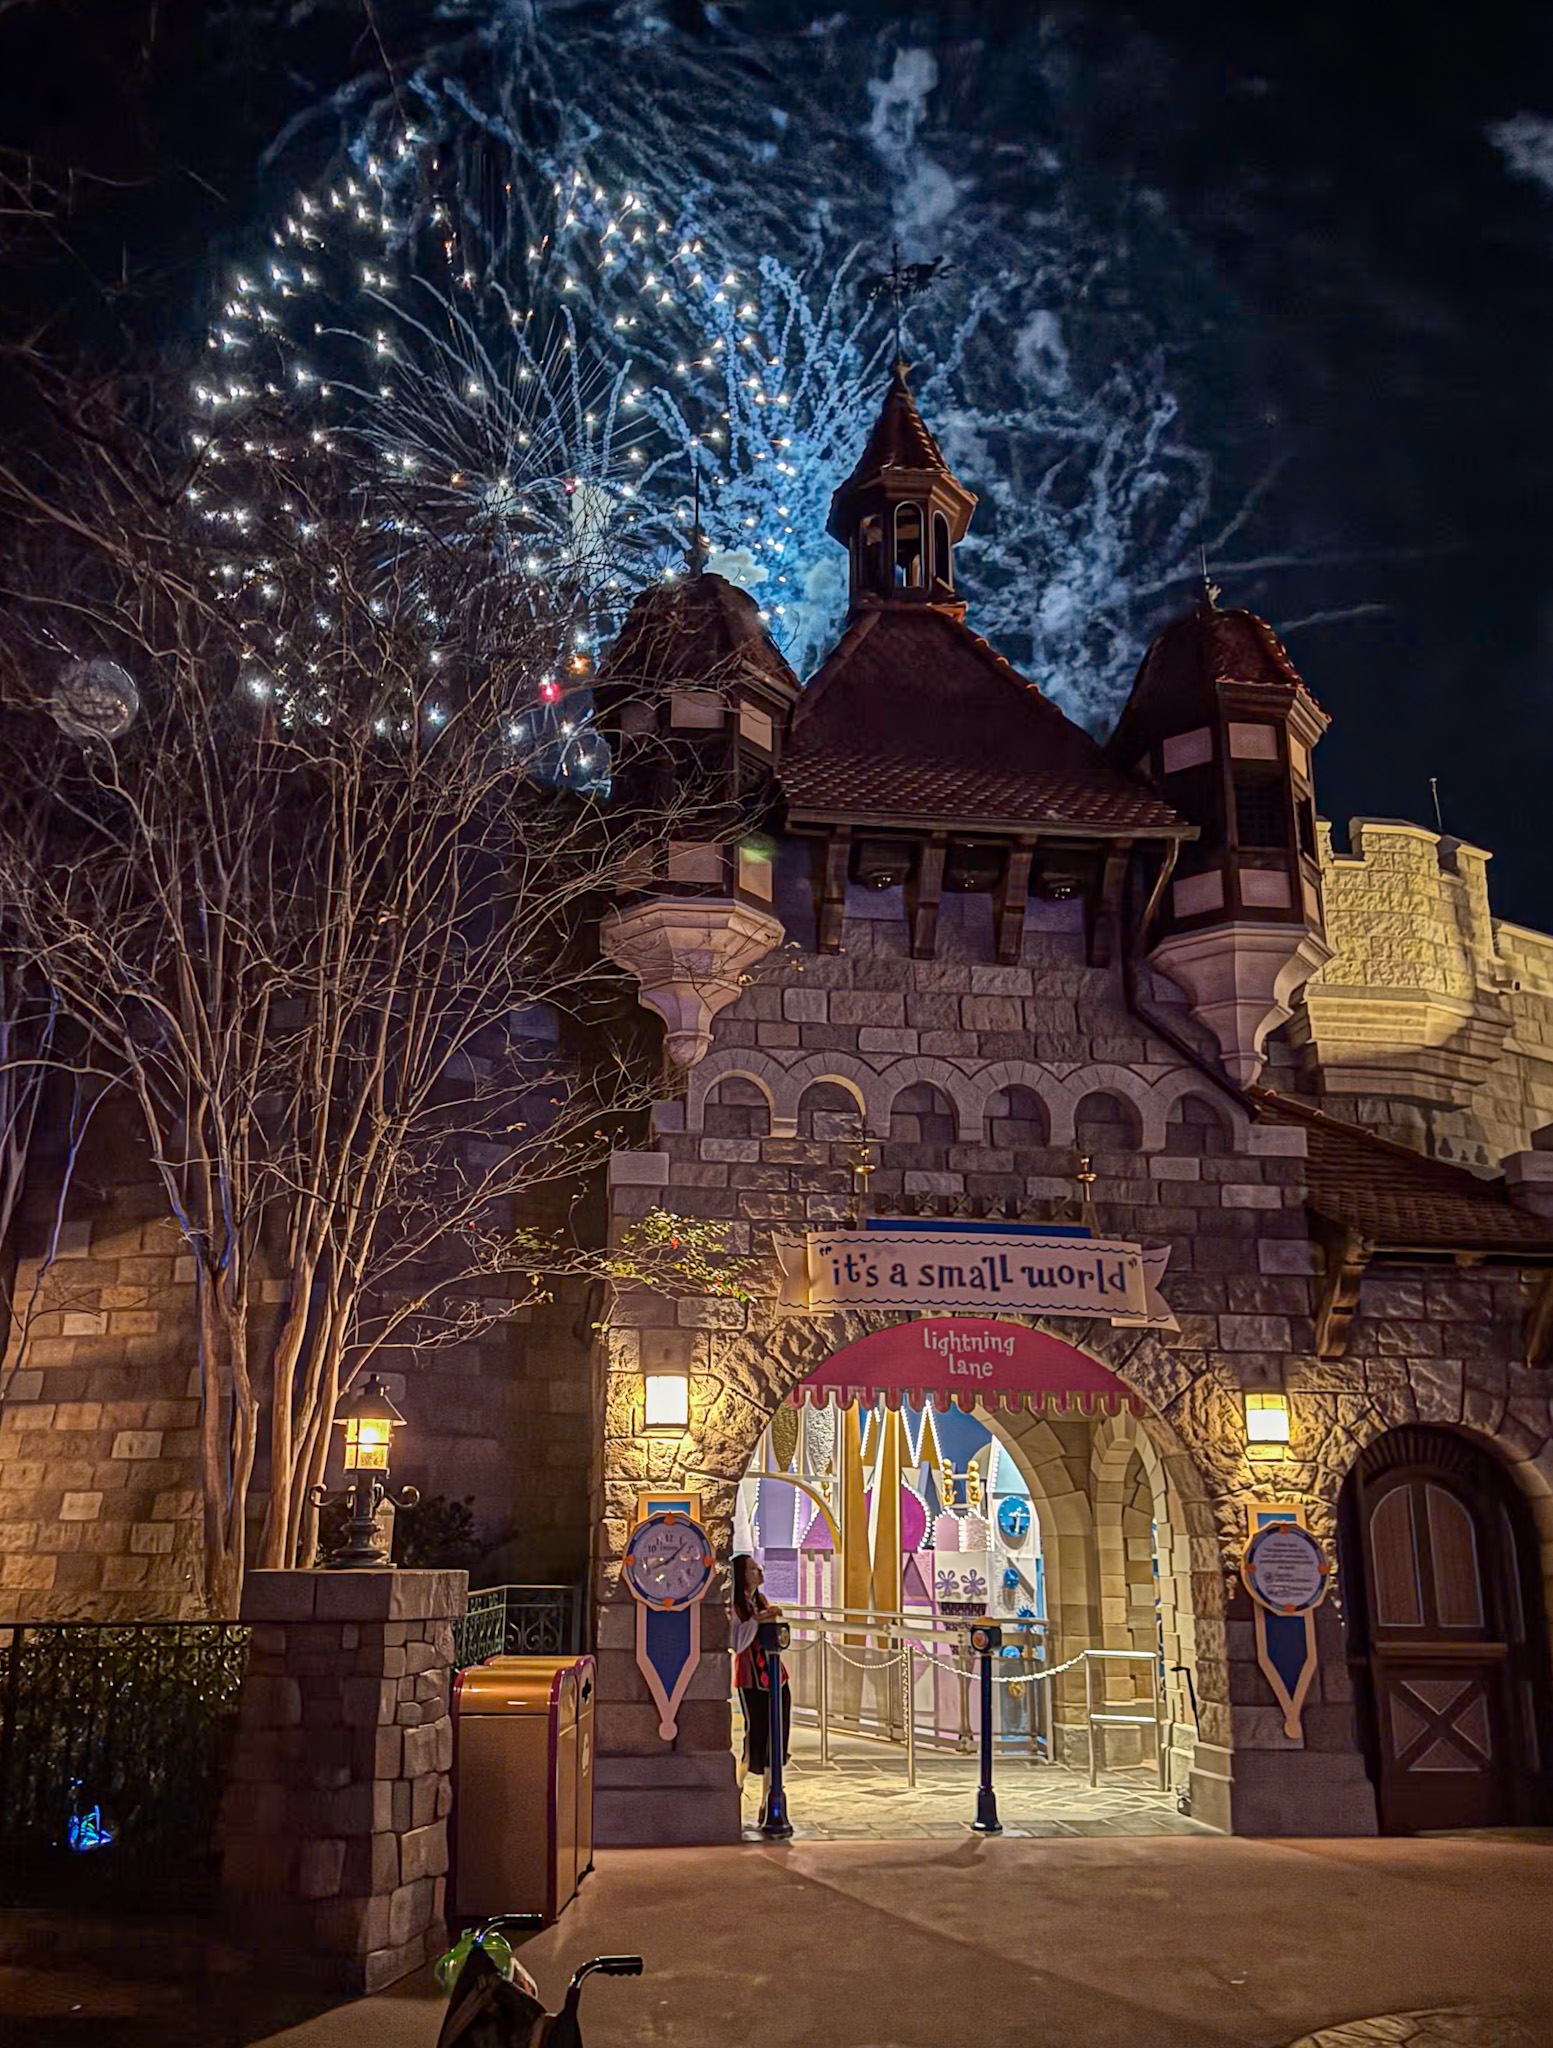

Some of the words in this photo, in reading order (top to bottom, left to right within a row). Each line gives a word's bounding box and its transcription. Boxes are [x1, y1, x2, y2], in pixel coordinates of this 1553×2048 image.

[889, 1263, 908, 1287] a
[918, 1254, 1013, 1292] small
[924, 1327, 1015, 1356] lightning
[949, 1353, 993, 1379] lane
